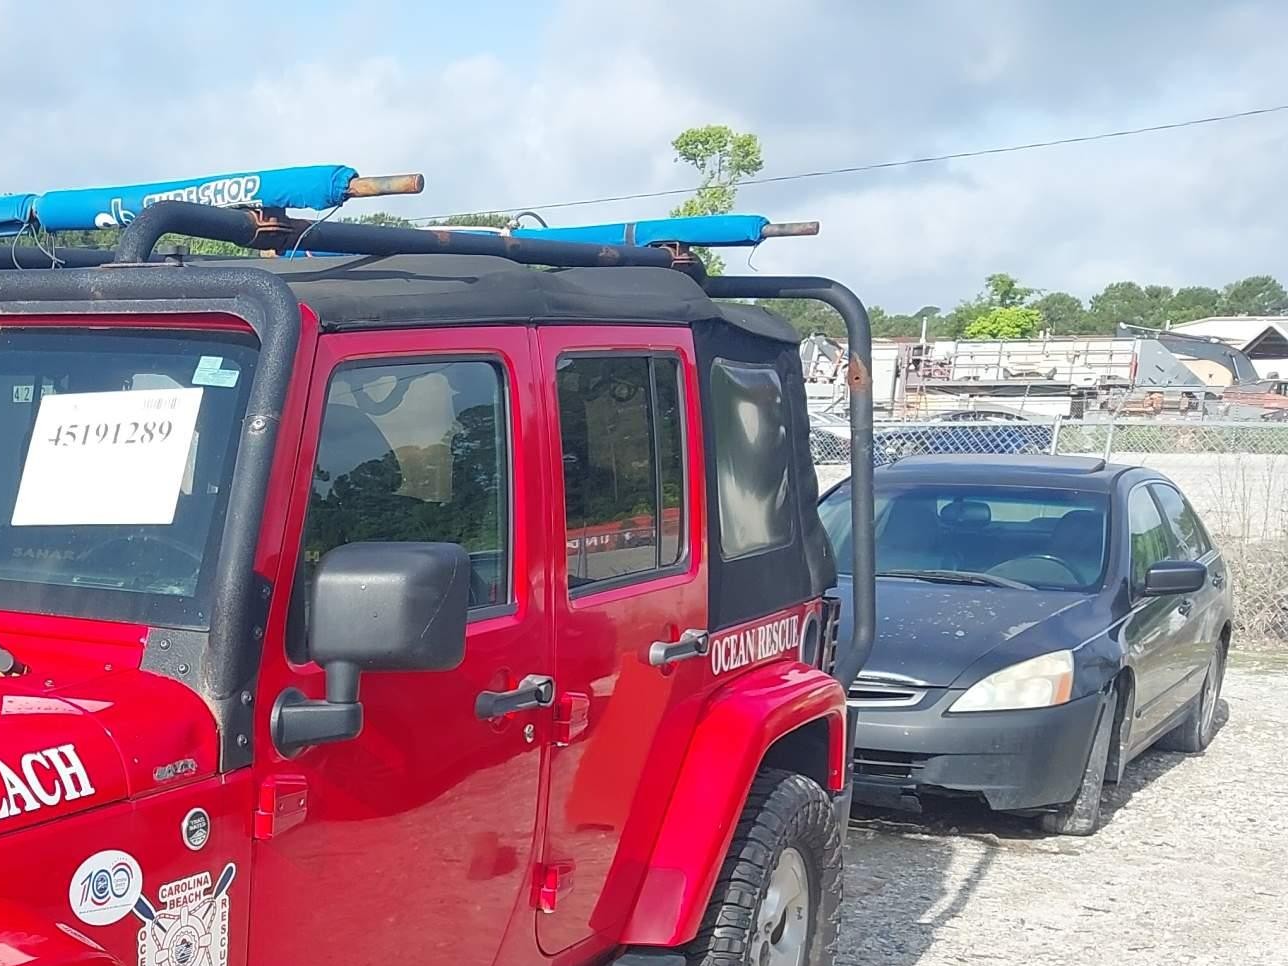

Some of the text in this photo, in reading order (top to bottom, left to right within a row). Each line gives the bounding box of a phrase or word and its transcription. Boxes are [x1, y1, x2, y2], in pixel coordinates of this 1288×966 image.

[47, 420, 173, 446] 45191289
[712, 615, 799, 676] OCEAN RESCUE
[160, 874, 210, 899] CAROLINA
[168, 889, 202, 910] BEACH
